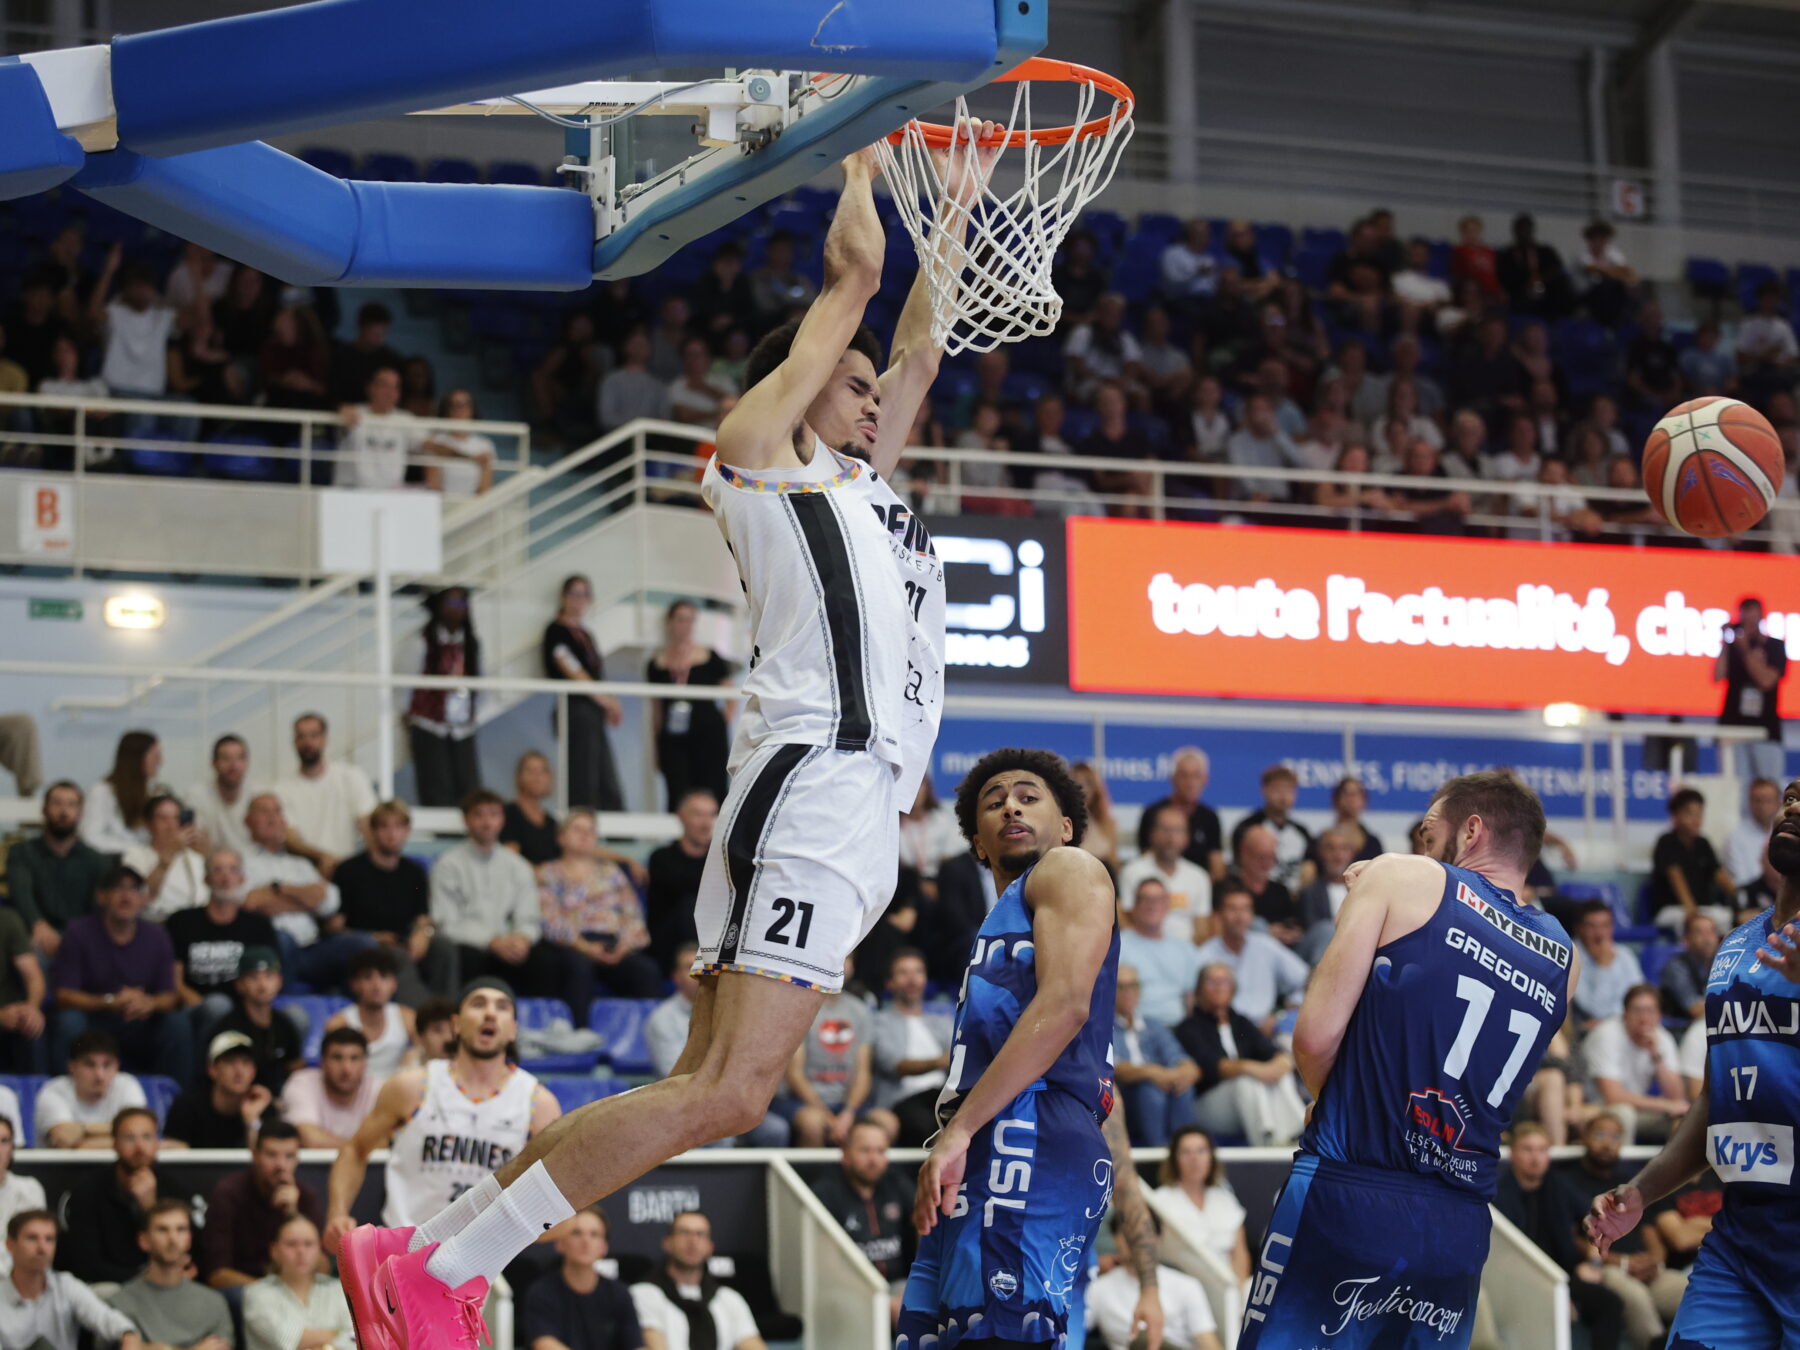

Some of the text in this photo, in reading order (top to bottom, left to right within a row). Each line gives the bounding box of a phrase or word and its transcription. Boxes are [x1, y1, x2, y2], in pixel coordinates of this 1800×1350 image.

[36, 489, 60, 530] B
[1148, 572, 1320, 640] toute
[764, 897, 814, 950] 21
[1458, 883, 1568, 968] MAYENNE
[1445, 927, 1557, 1016] GREGOIRE
[1730, 1066, 1758, 1100] 17
[984, 1119, 1036, 1228] USL
[1713, 1135, 1779, 1172] Krys
[1321, 1275, 1465, 1341] Festiconcept
